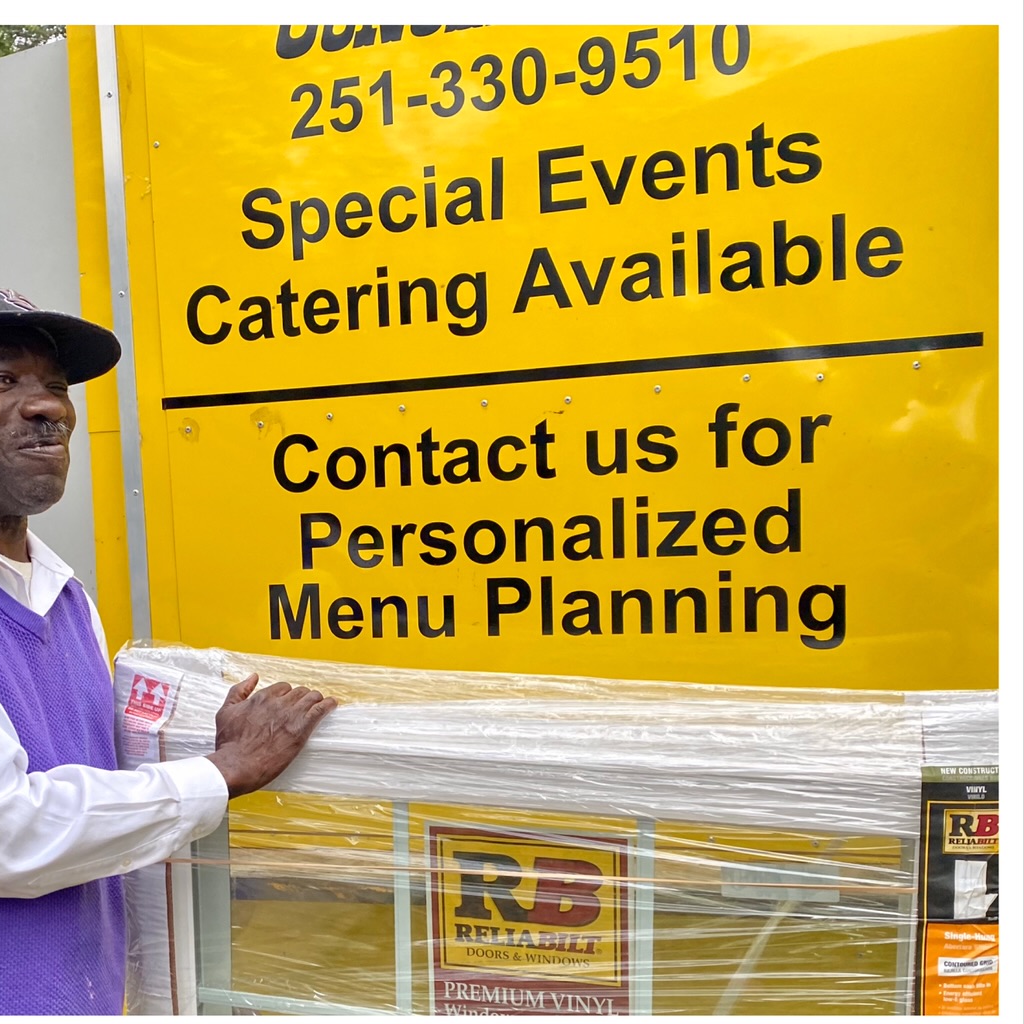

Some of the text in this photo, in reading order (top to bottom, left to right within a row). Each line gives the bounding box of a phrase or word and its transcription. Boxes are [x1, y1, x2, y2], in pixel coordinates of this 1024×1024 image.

[291, 25, 750, 139] 251-330-9510
[241, 122, 822, 261] Special Events
[186, 213, 904, 345] Catering Available
[273, 402, 832, 493] Contact us for
[300, 488, 802, 570] Personalized
[268, 572, 847, 650] Menu Planning
[940, 767, 956, 775] NEW
[949, 814, 999, 837] RB
[453, 850, 603, 928] RB
[454, 923, 602, 955] RELIABILT
[466, 947, 590, 968] DOORS & WINDOWS
[443, 980, 619, 1016] PREMIUM VINYL
